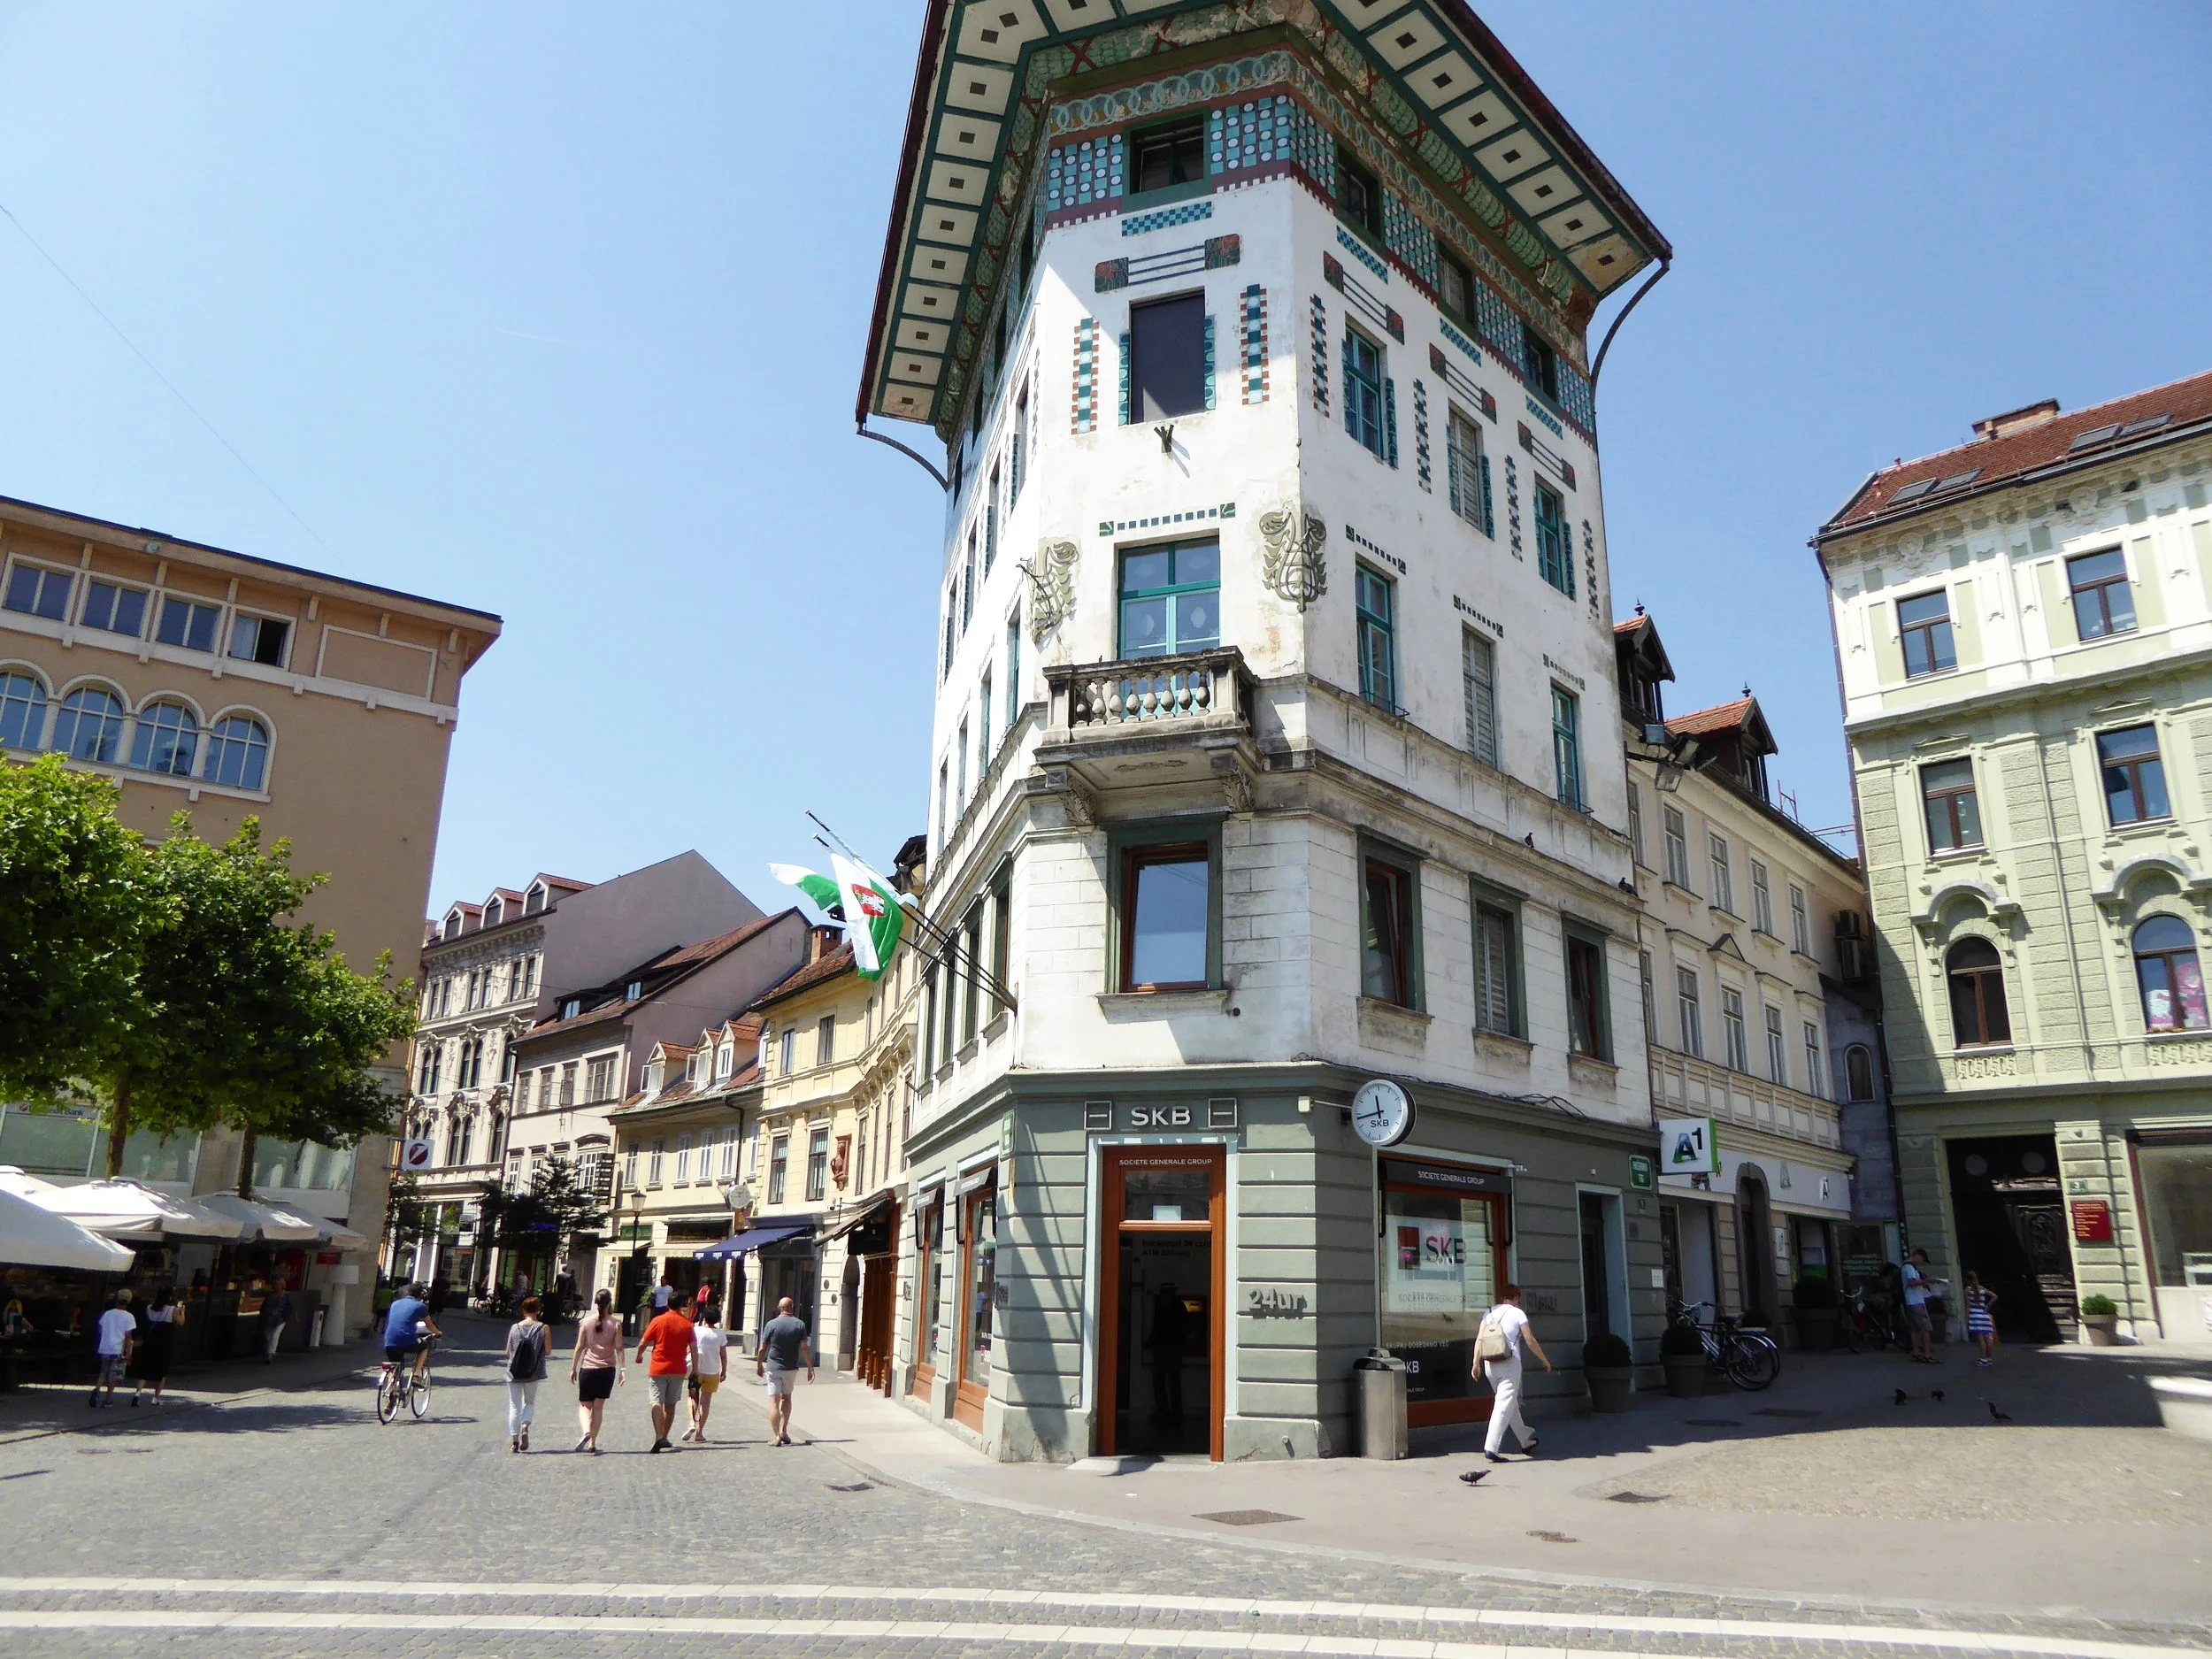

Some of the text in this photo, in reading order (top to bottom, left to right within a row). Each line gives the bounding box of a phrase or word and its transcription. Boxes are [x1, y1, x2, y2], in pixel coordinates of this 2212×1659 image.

[1131, 1105, 1191, 1126] SKB
[1371, 1119, 1389, 1128] SKB
[1672, 1127, 1703, 1164] A1
[1417, 1171, 1440, 1180] SOCIETE
[1440, 1174, 1466, 1184] GENERALE
[1406, 1360, 1420, 1373] KB
